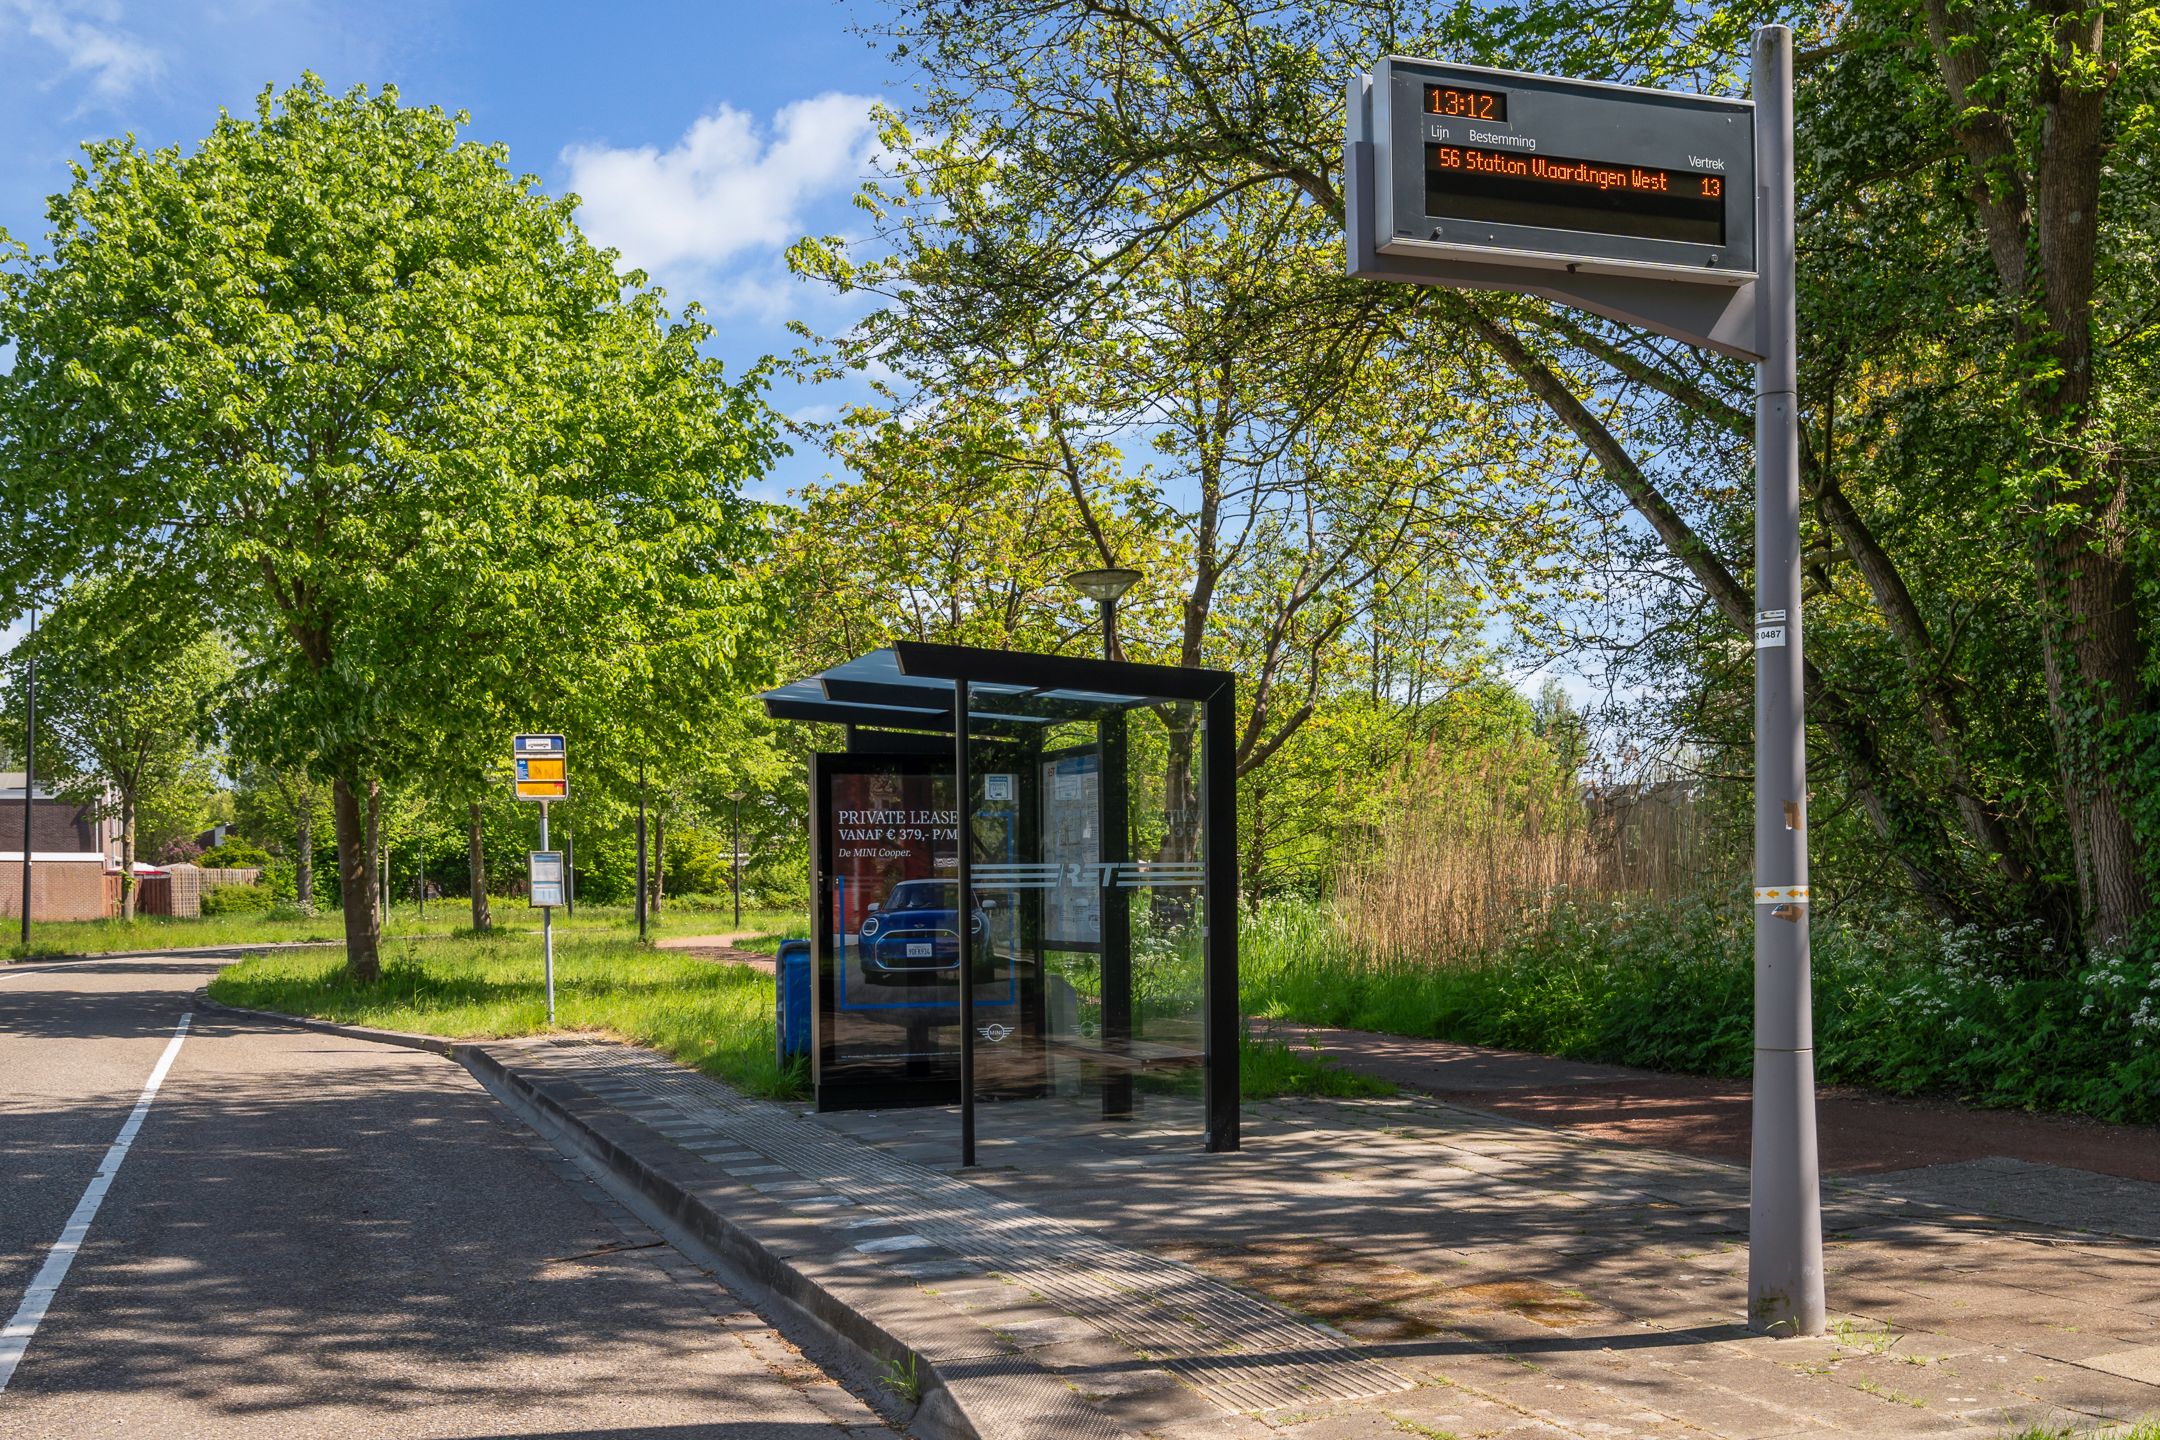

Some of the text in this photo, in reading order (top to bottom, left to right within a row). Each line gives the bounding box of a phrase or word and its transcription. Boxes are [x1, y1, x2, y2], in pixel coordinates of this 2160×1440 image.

[1432, 89, 1493, 119] 13:12
[1431, 124, 1725, 170] Lijn Bestemming Vertrek
[1440, 148, 1720, 196] 56 Station Vlaardingen West 13
[1761, 630, 1781, 639] 0487
[838, 810, 960, 825] PRIVATE LEASE
[838, 828, 883, 840] VANAF
[885, 828, 896, 840] €
[899, 828, 930, 842] 379,-
[838, 848, 912, 859] De MINI Cooper.
